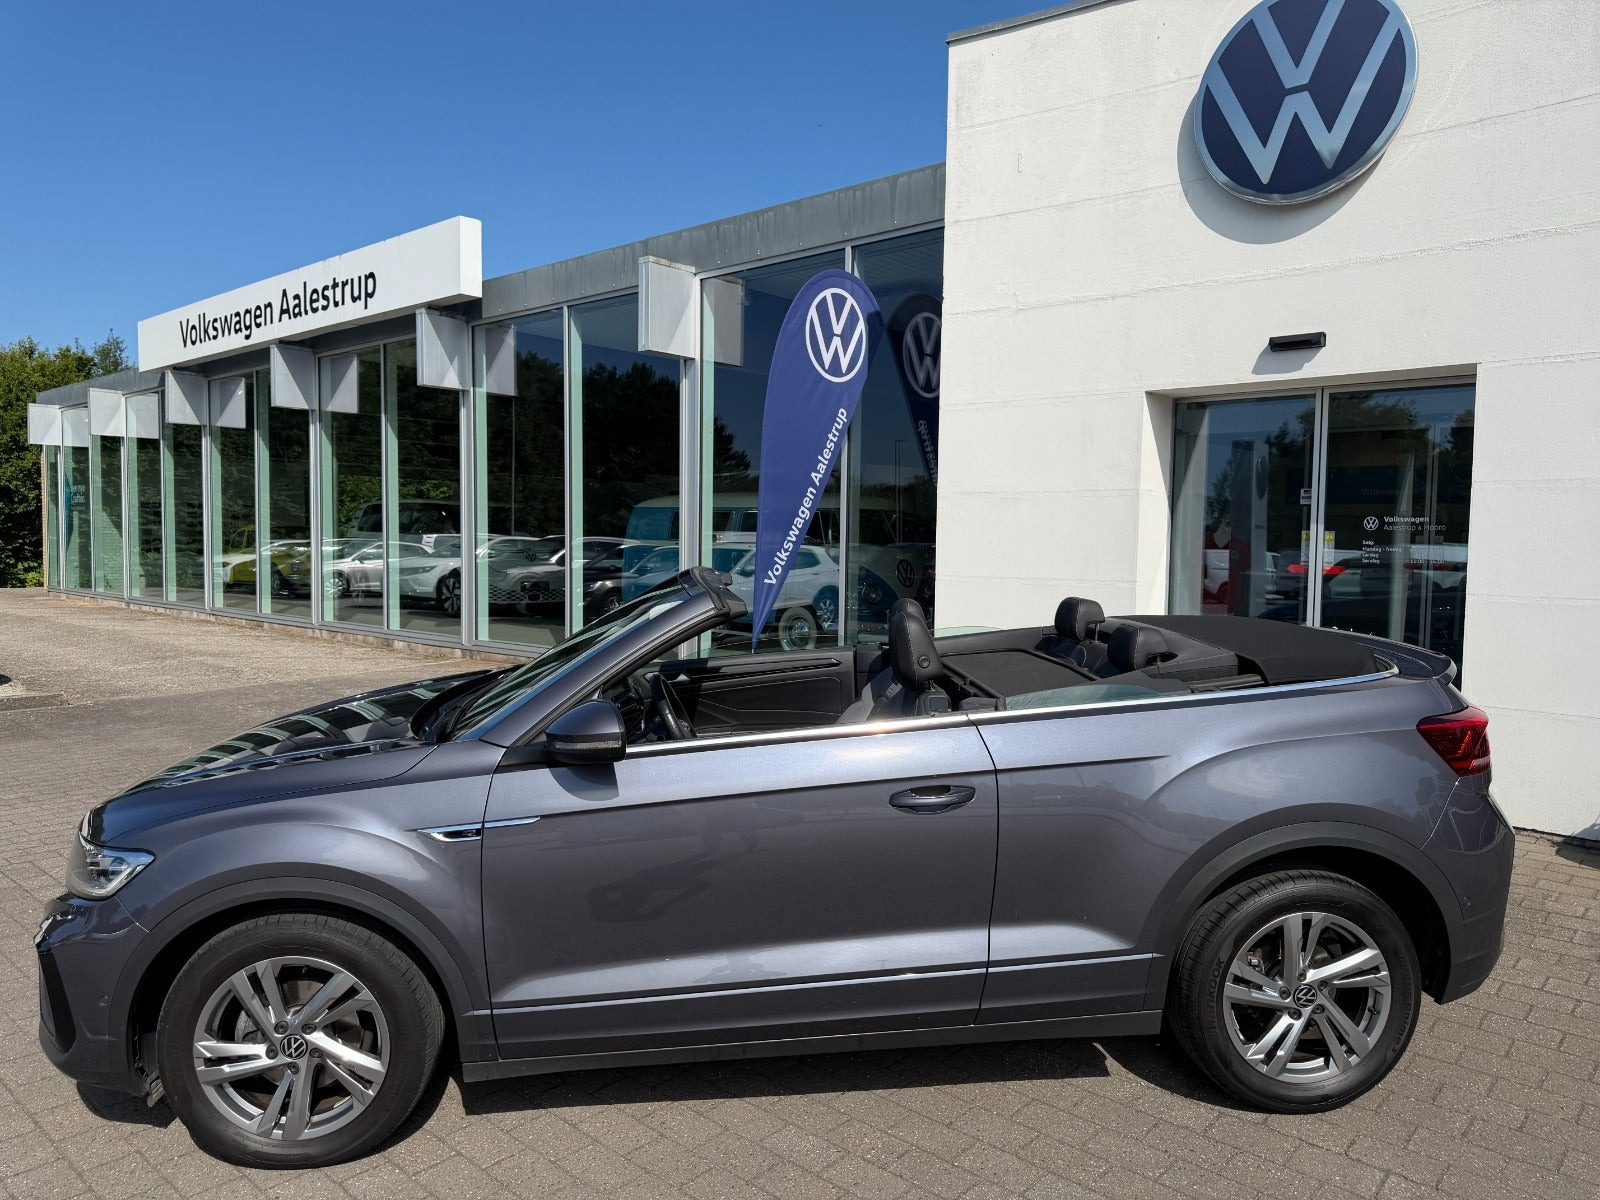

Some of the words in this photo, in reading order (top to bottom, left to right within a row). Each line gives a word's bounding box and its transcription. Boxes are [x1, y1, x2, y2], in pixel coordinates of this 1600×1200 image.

[179, 301, 274, 349] Volkswagen
[278, 271, 377, 323] Aalestrup
[805, 287, 867, 383] VW
[763, 487, 817, 586] Volkswagen
[810, 407, 847, 487] Aalestrup
